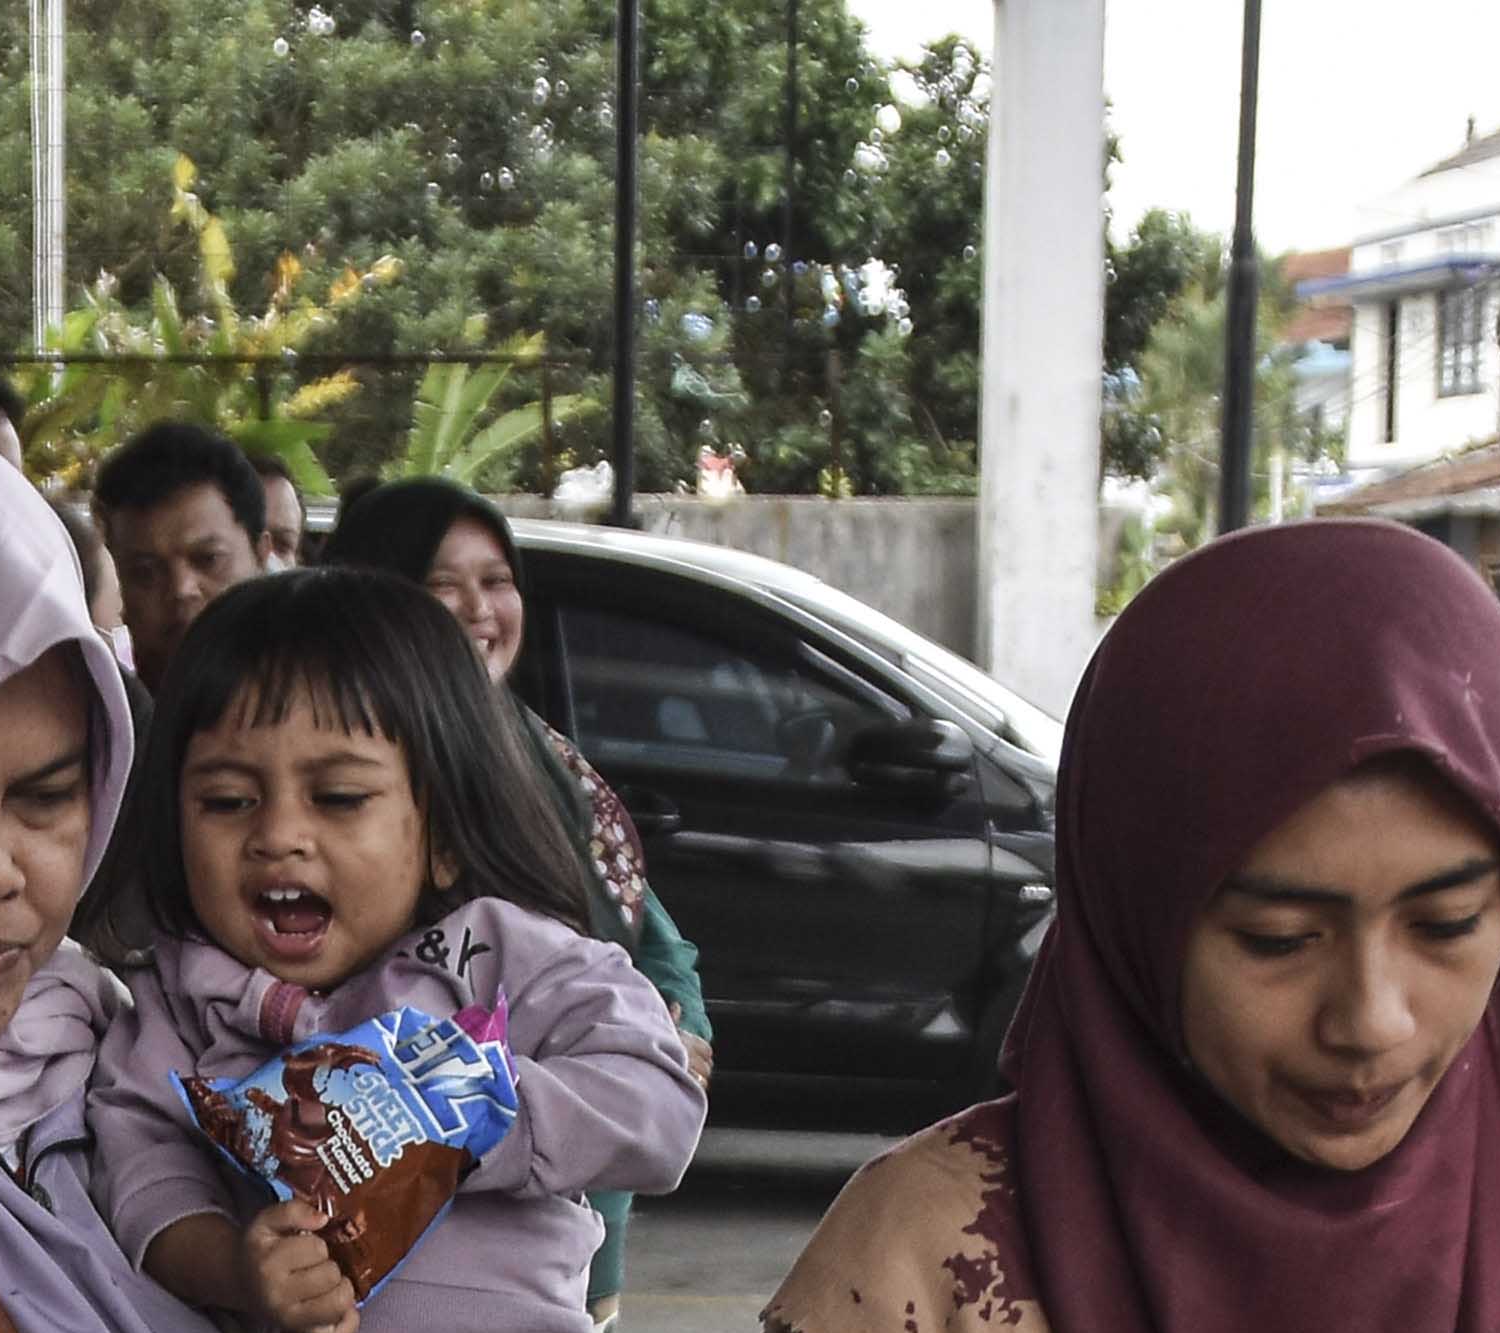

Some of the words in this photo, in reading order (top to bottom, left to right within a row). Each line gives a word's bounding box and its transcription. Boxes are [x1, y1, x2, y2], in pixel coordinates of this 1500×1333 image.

[351, 1072, 428, 1145] SWEET
[327, 1135, 363, 1185] Flavour
[328, 1110, 374, 1179] Chocolate
